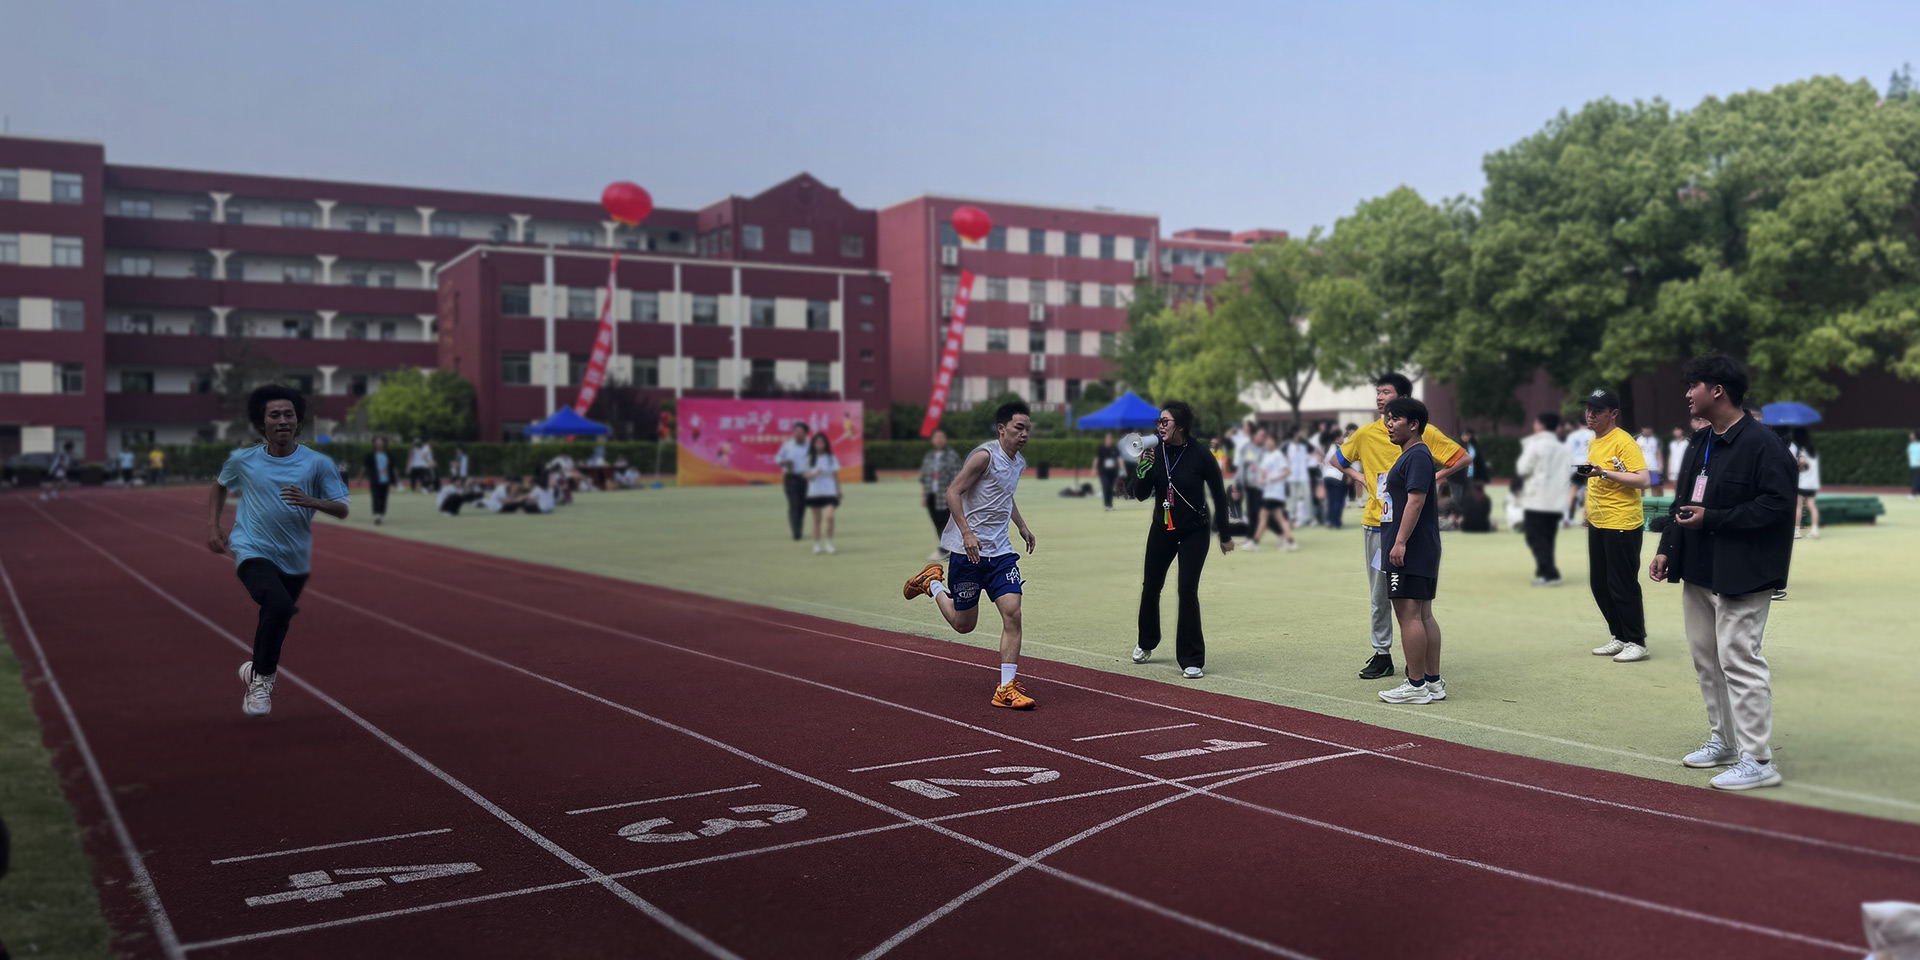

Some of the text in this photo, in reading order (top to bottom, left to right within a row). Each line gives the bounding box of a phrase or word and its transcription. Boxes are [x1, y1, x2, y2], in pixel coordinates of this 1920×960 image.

[1139, 738, 1270, 762] 1
[890, 766, 1061, 800] 2
[615, 804, 809, 844] 3
[245, 862, 482, 907] 4
